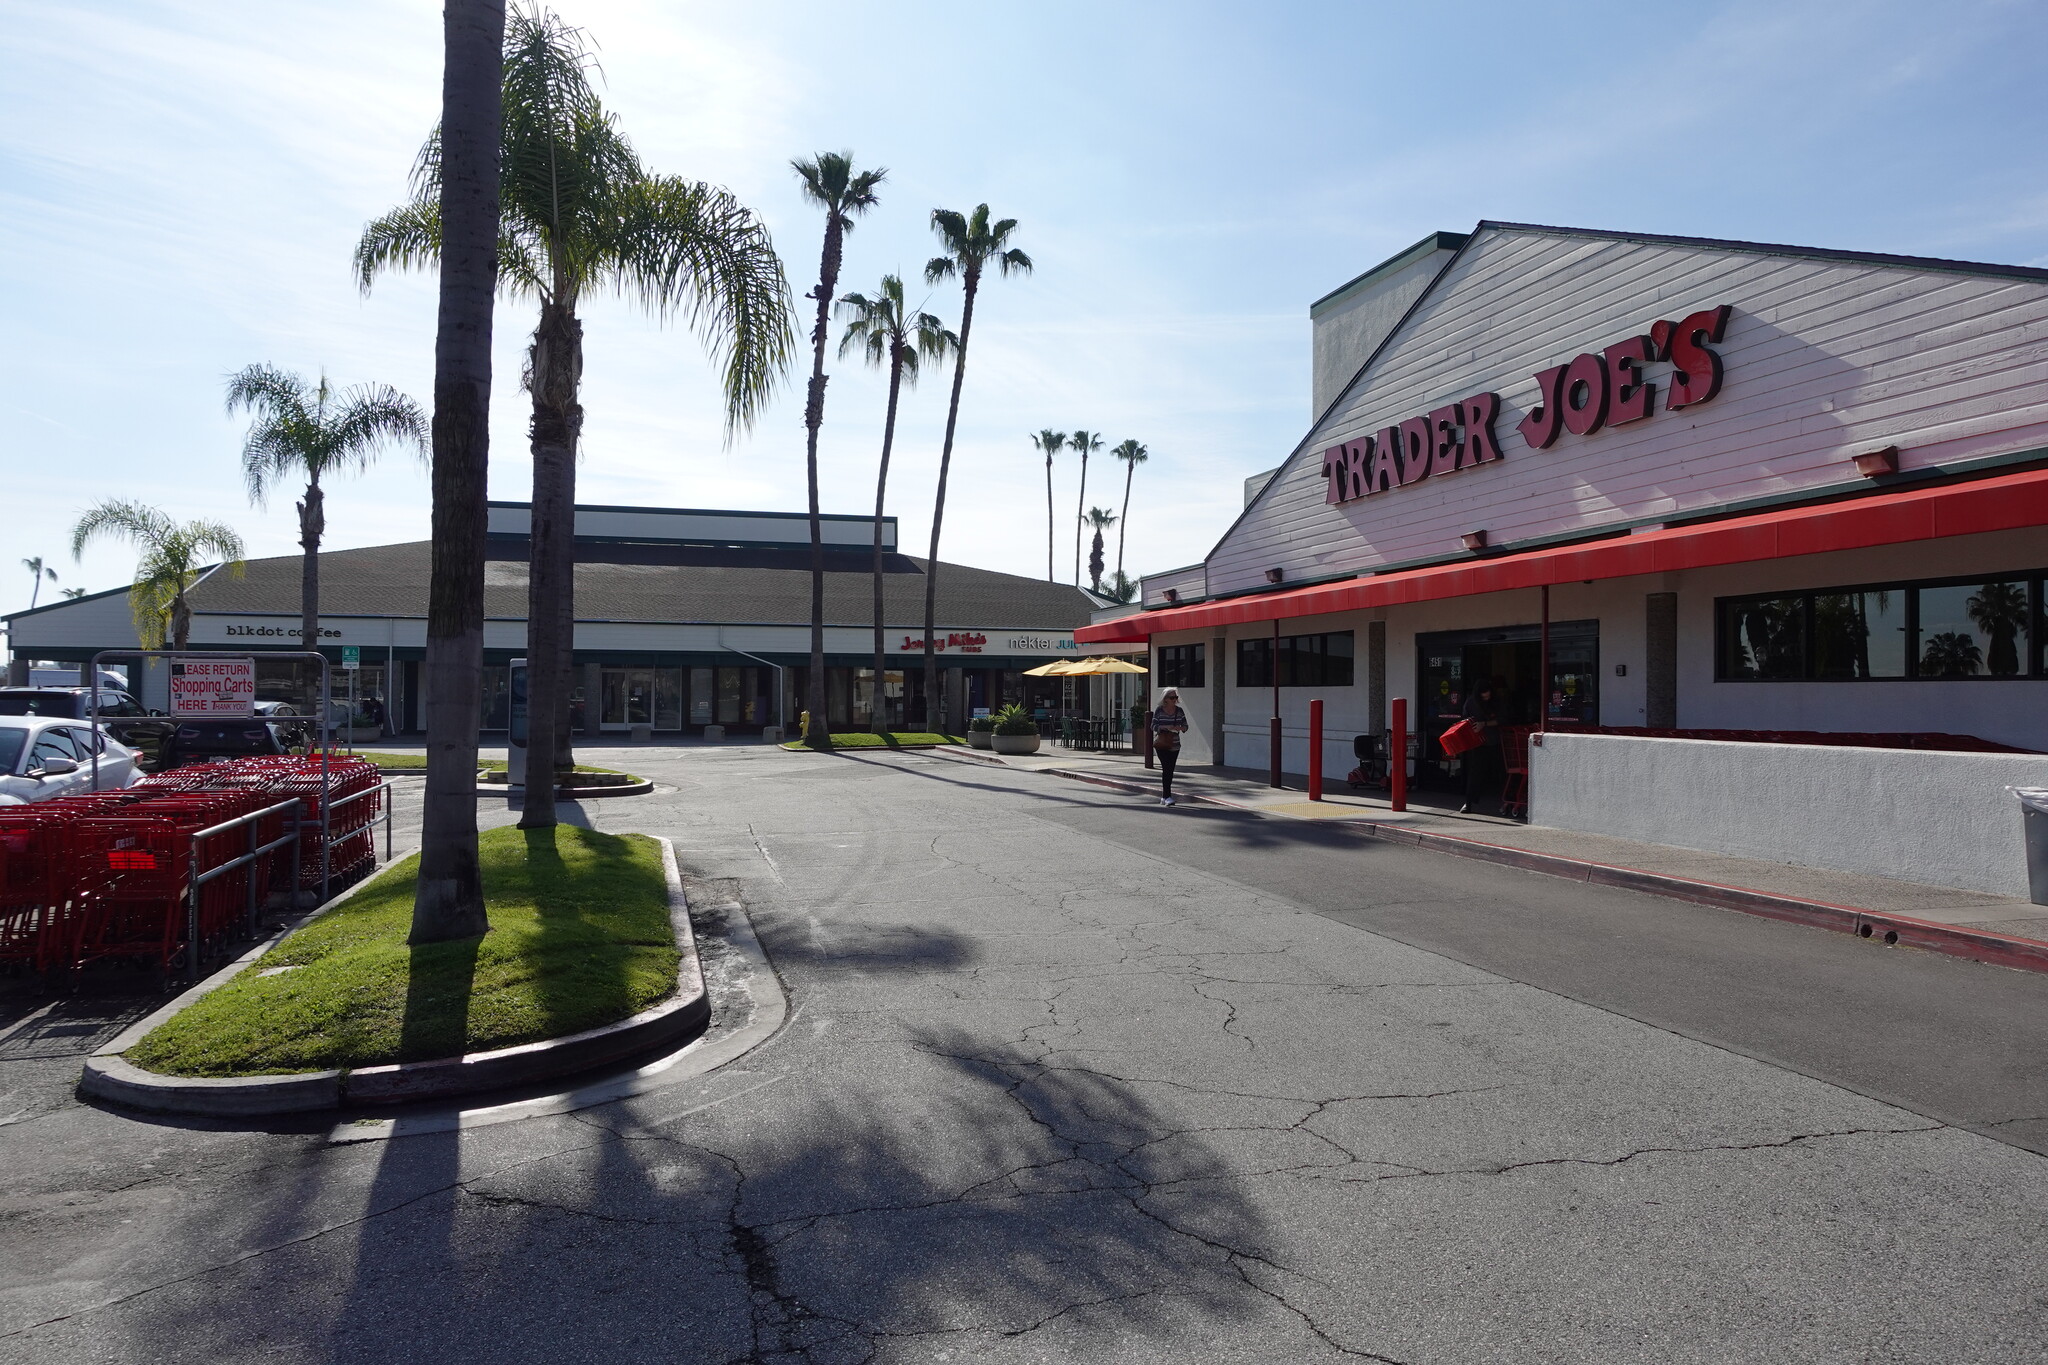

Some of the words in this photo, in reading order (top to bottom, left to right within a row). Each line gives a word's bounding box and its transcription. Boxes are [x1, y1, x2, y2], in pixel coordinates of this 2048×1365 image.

[1321, 392, 1504, 505] TRADER
[1515, 304, 1733, 449] JOE'S
[288, 627, 342, 638] cofee
[901, 636, 945, 651] Jerey
[178, 664, 210, 675] EASE
[212, 664, 250, 675] RETURN
[172, 677, 221, 696] Shopping
[224, 677, 253, 693] Carts
[178, 700, 207, 710] HERE
